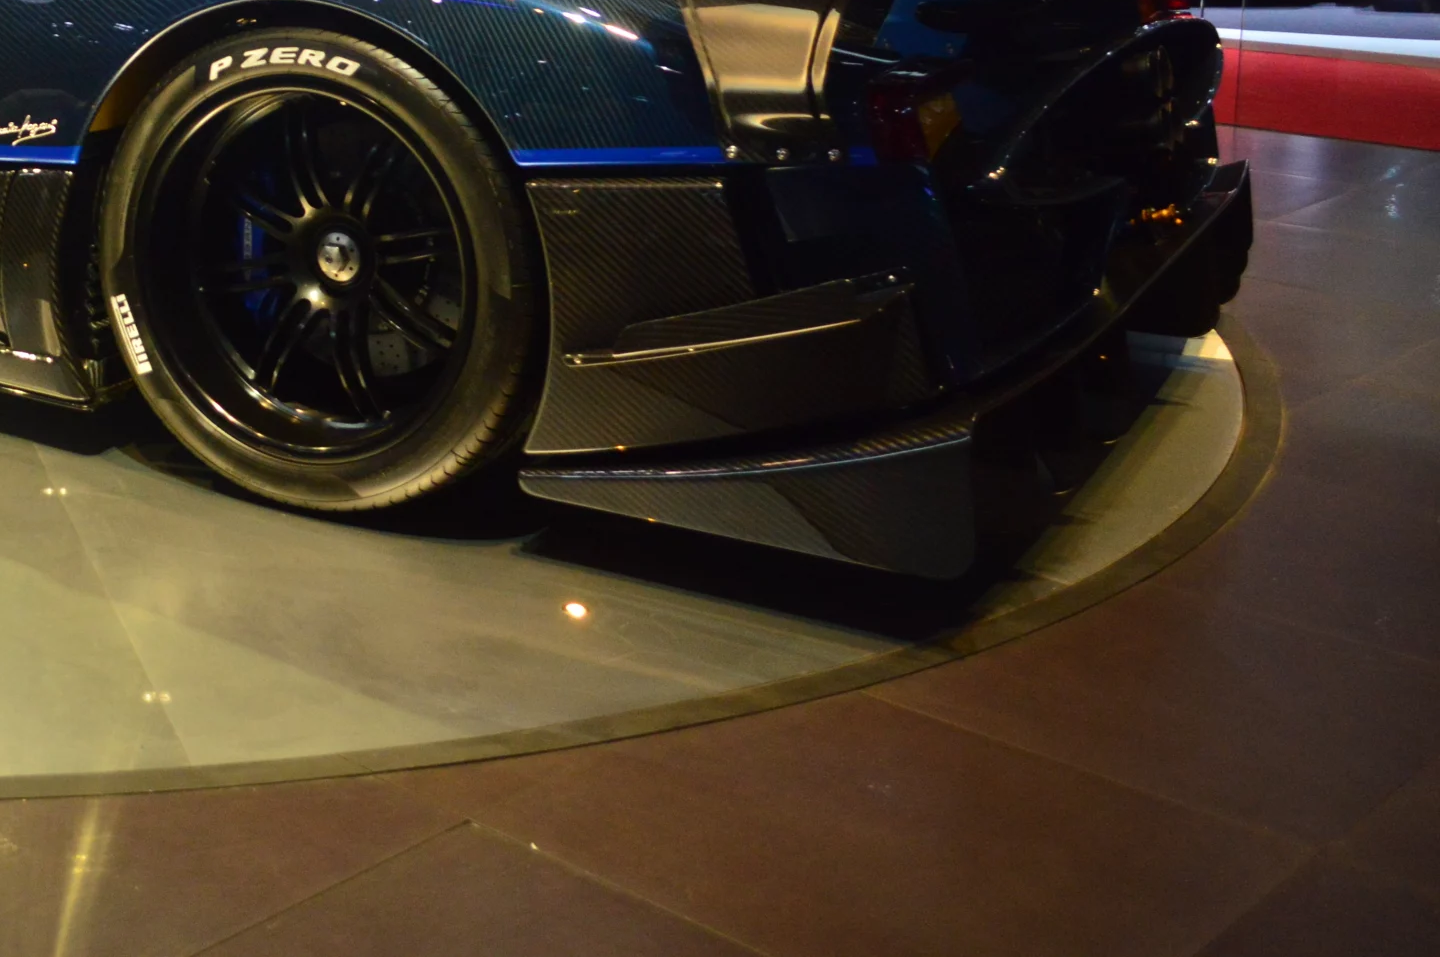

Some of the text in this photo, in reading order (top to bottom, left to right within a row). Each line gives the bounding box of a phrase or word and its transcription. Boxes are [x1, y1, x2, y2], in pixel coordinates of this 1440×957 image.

[208, 46, 362, 82] P ZERO
[110, 293, 153, 375] PIRELLI
